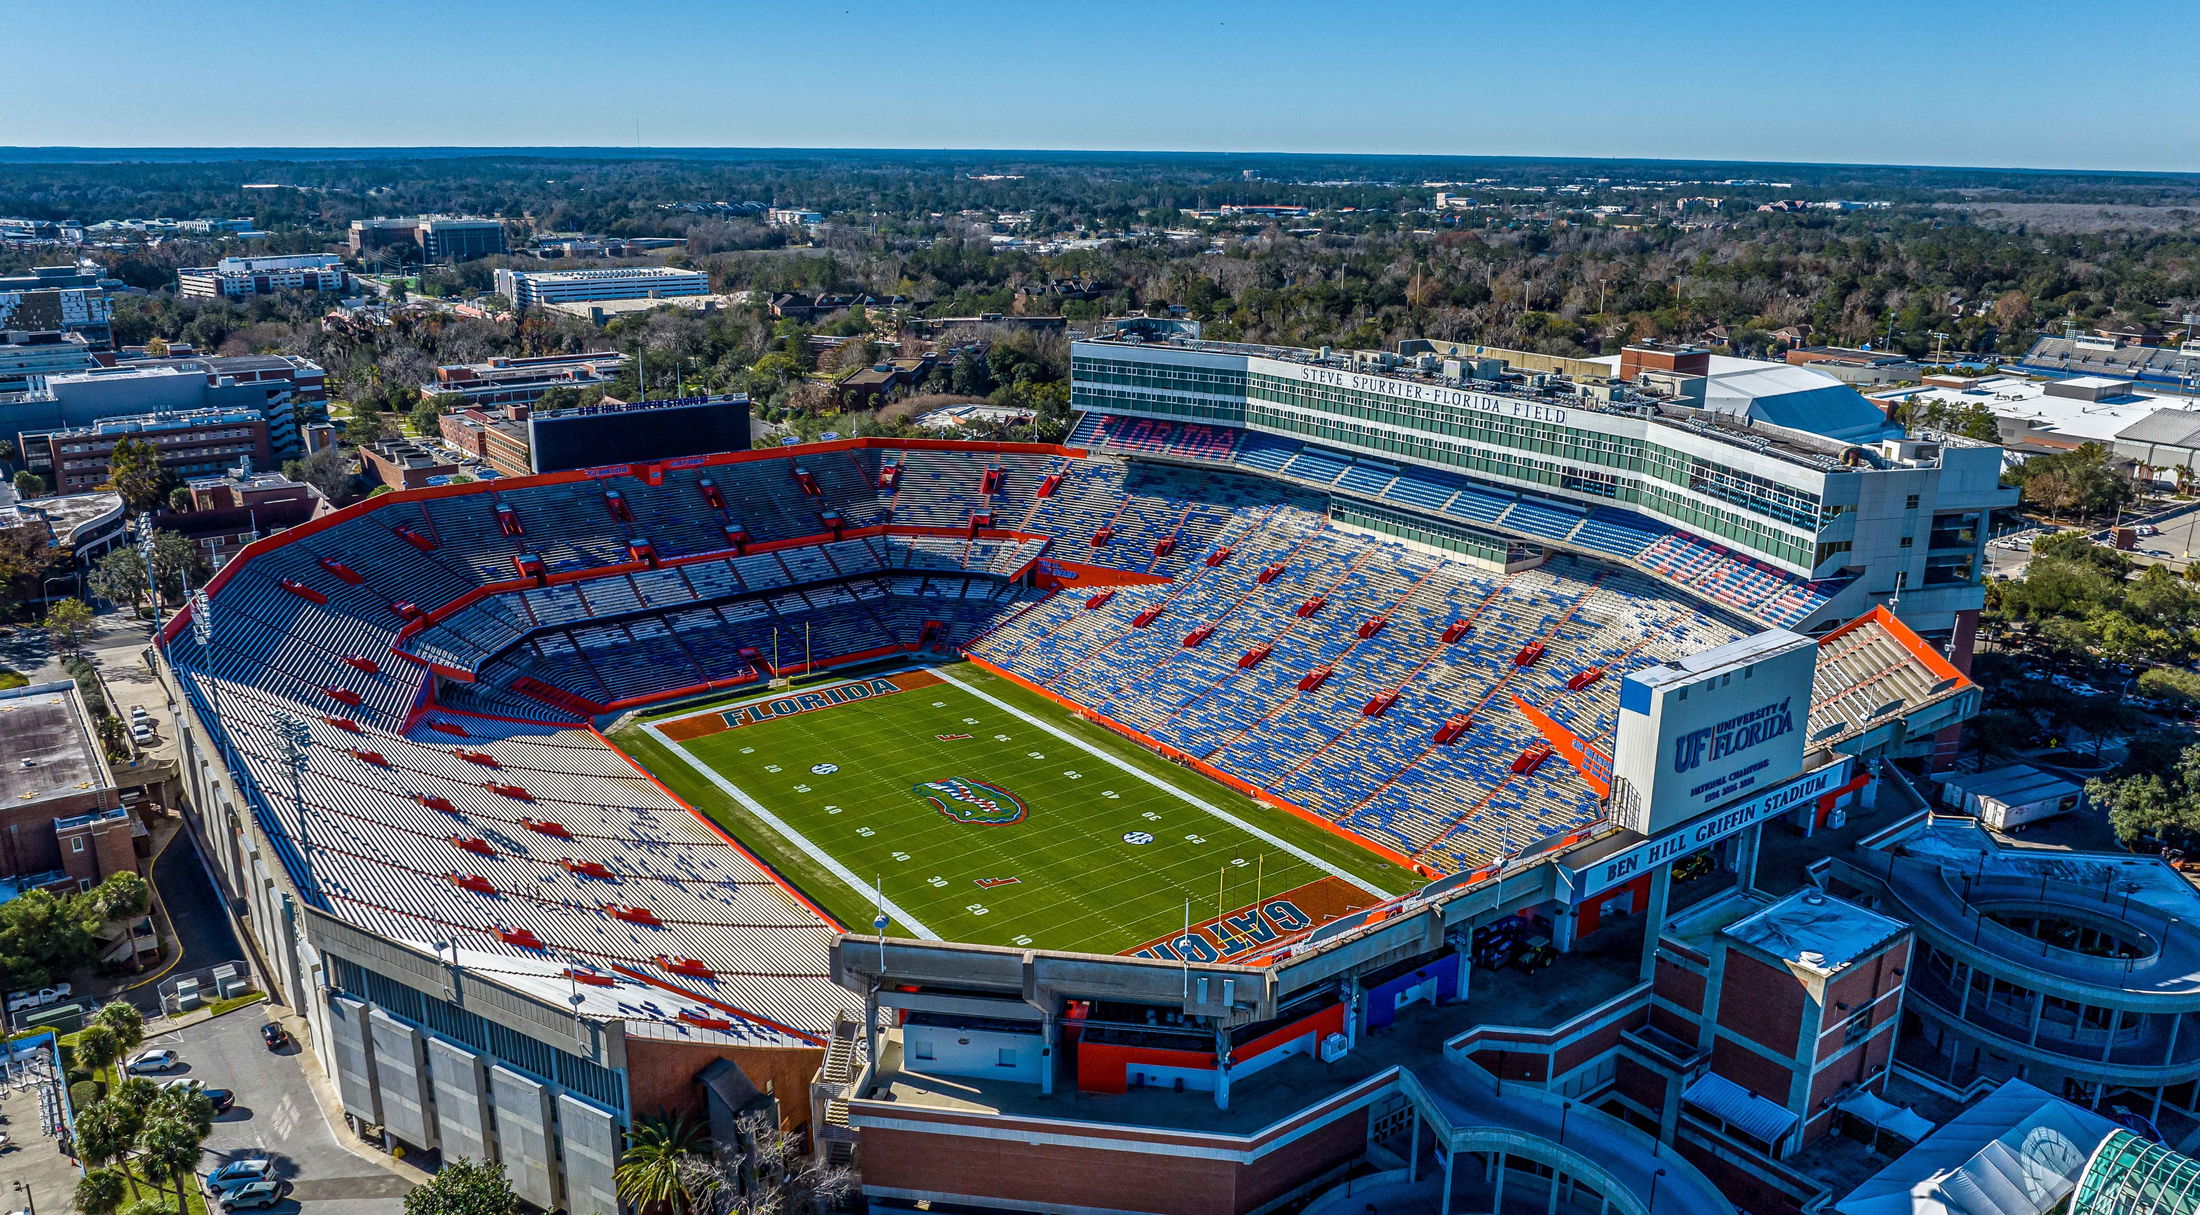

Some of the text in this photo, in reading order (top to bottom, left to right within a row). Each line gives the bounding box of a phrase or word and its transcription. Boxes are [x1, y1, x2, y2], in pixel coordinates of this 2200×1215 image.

[1302, 367, 1343, 385] STEVE
[1513, 402, 1566, 423] FIELD
[579, 396, 708, 416] BEN HILL GRIFFIN STADIUM
[720, 678, 902, 729] FLORIDA
[1716, 696, 1791, 733] UNIVERSITY of
[1713, 711, 1794, 760] FLORIDA
[1675, 727, 1712, 773] UF
[764, 764, 782, 773] 20
[793, 783, 812, 793] 30
[824, 805, 842, 814] 40
[856, 826, 875, 837] 50
[1606, 774, 1828, 882] BEN HILL GRIFFIN STADIUM
[891, 851, 910, 862] 40
[927, 876, 948, 888] 30
[966, 904, 989, 916] 20
[1012, 934, 1033, 946] 10
